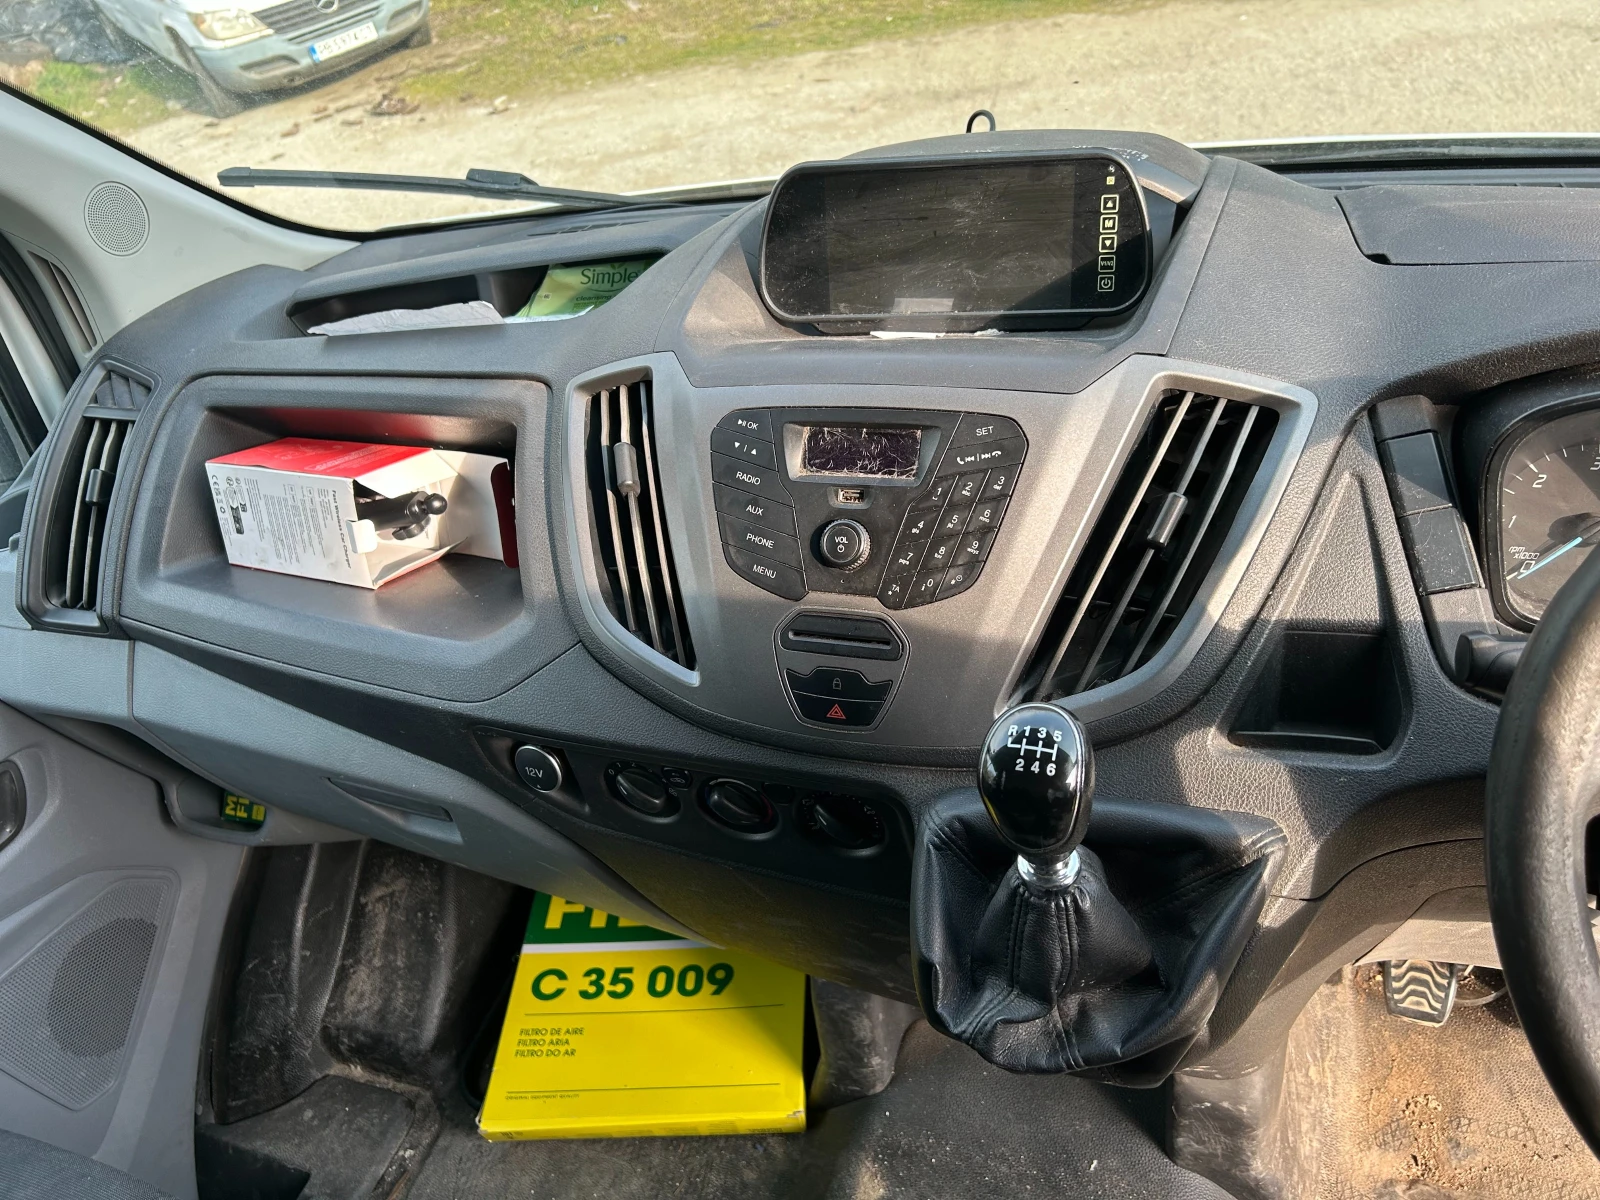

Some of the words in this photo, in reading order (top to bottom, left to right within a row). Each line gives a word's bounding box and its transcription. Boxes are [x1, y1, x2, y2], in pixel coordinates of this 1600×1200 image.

[1104, 219, 1114, 228] M
[580, 268, 638, 288] Simple
[747, 421, 759, 431] OK
[975, 425, 994, 437] SET
[735, 470, 761, 486] RADIO
[997, 476, 1005, 485] 3
[1532, 474, 1548, 488] 2
[965, 482, 973, 491] 2
[745, 504, 764, 517] AUX
[984, 509, 991, 518] 6
[951, 514, 959, 524] 5
[1508, 514, 1517, 529] 1
[917, 520, 925, 529] 4
[746, 532, 775, 549] PHONE
[834, 536, 849, 544] VOL
[971, 540, 979, 550] 9
[938, 546, 946, 555] 8
[1508, 546, 1526, 555] rpm
[906, 552, 914, 561] 7
[752, 563, 777, 579] MENU
[926, 578, 934, 588] 0
[1007, 724, 1019, 736] R
[1023, 725, 1031, 737] 1
[1037, 727, 1047, 739] 3
[1053, 730, 1063, 742] 5
[525, 766, 543, 778] 12V
[1015, 758, 1025, 772] 2
[1030, 760, 1040, 774] 4
[1046, 763, 1056, 776] 6
[531, 968, 569, 1001] C
[578, 966, 634, 1000] 35
[647, 962, 735, 998] 009
[519, 1027, 548, 1037] FILTRO
[550, 1027, 563, 1036] DE
[564, 1027, 585, 1036] AIRE
[517, 1038, 547, 1047] FILTRO
[548, 1038, 570, 1047] ARIA
[514, 1048, 544, 1058] FILTRO
[545, 1048, 562, 1057] DO
[563, 1048, 577, 1057] AR
